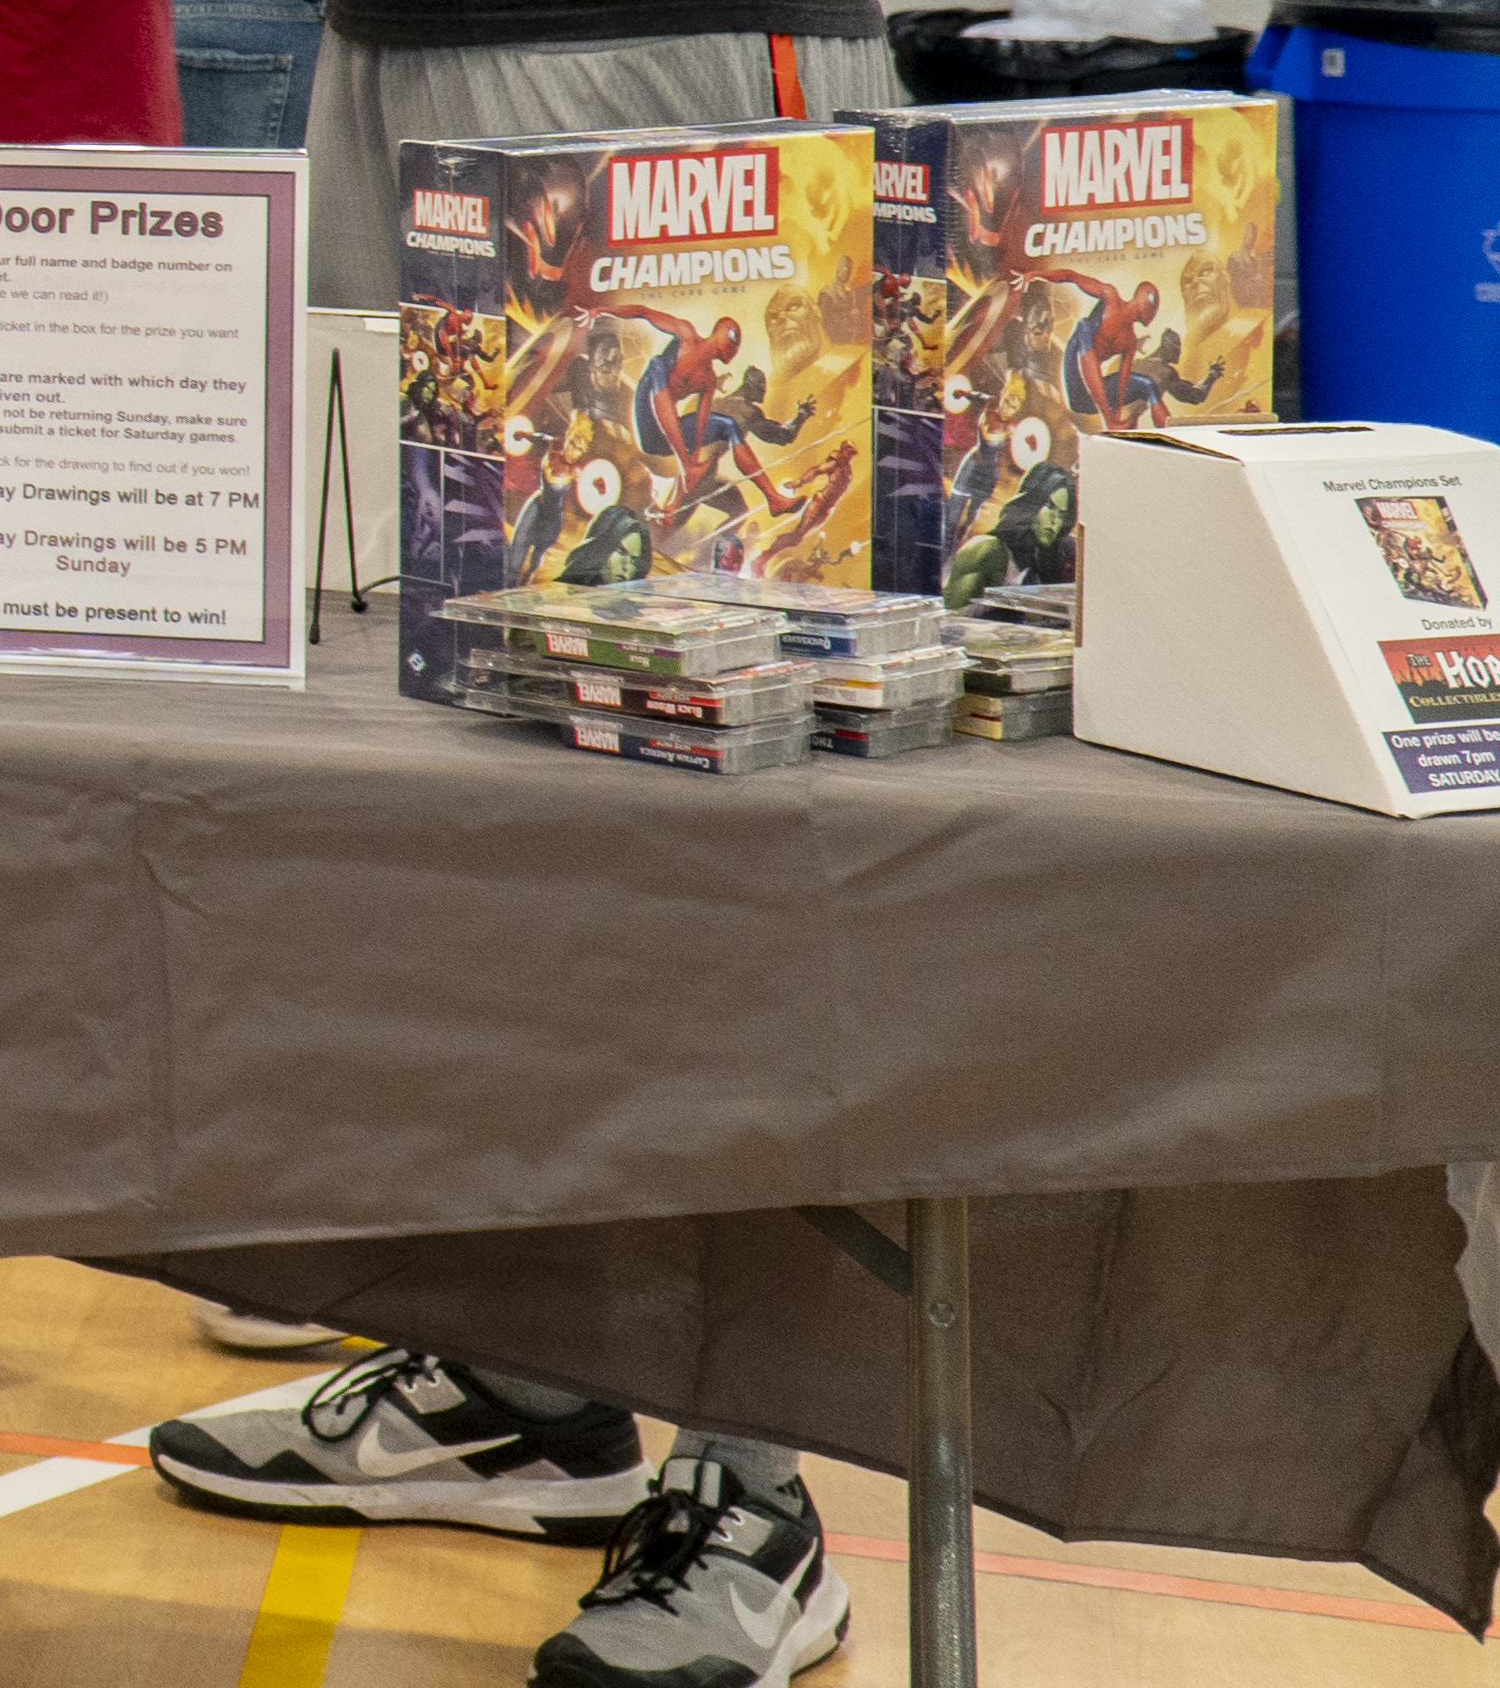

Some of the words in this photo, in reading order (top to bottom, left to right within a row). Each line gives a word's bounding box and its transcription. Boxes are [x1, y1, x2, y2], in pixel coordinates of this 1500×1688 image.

[1045, 125, 1189, 209] MARVEL
[612, 154, 774, 240] MARVEL
[90, 200, 224, 238] Prizes
[414, 190, 487, 234] MARVEL
[407, 232, 496, 258] CHAMPIONS
[1025, 213, 1206, 257] CHAMPIONS
[15, 255, 36, 266] full
[40, 258, 76, 268] name
[81, 257, 107, 269] and
[111, 258, 153, 272] badge
[157, 260, 210, 272] number
[215, 263, 233, 273] on
[590, 245, 795, 293] CHAMPIONS
[712, 285, 747, 296] GAME
[0, 373, 23, 383] are
[29, 372, 85, 385] marked
[90, 374, 123, 387] with
[128, 375, 174, 389] which
[179, 377, 207, 392] day
[213, 378, 247, 393] they
[35, 392, 65, 403] out.
[23, 483, 110, 506] Drawings
[117, 487, 148, 504] will
[155, 489, 178, 506] be
[185, 491, 203, 506] at
[210, 492, 221, 507] 7
[228, 492, 260, 509] PM
[1323, 479, 1366, 493] Marvel
[1368, 476, 1439, 491] Champions
[1442, 475, 1462, 488] Set
[24, 531, 116, 553] Drawings
[123, 535, 156, 552] will
[164, 537, 187, 553] be
[195, 538, 207, 553] 5
[216, 539, 247, 555] PM
[56, 555, 131, 577] Sunday
[3, 601, 49, 617] must
[56, 601, 78, 618] be
[85, 604, 157, 623] present
[163, 607, 182, 624] to
[188, 608, 226, 626] win!
[1421, 617, 1475, 631] Donated
[1478, 616, 1493, 630] by
[548, 633, 588, 657] MARVEL
[578, 681, 621, 706] MARVEL
[576, 726, 620, 753] MARVEL
[1391, 733, 1421, 749] One
[1422, 732, 1456, 749] prize
[1457, 729, 1482, 744] will
[1482, 728, 1500, 742] be
[1417, 753, 1461, 768] drawn
[1461, 750, 1496, 765] 7pm
[1428, 769, 1500, 788] SATURDAY
